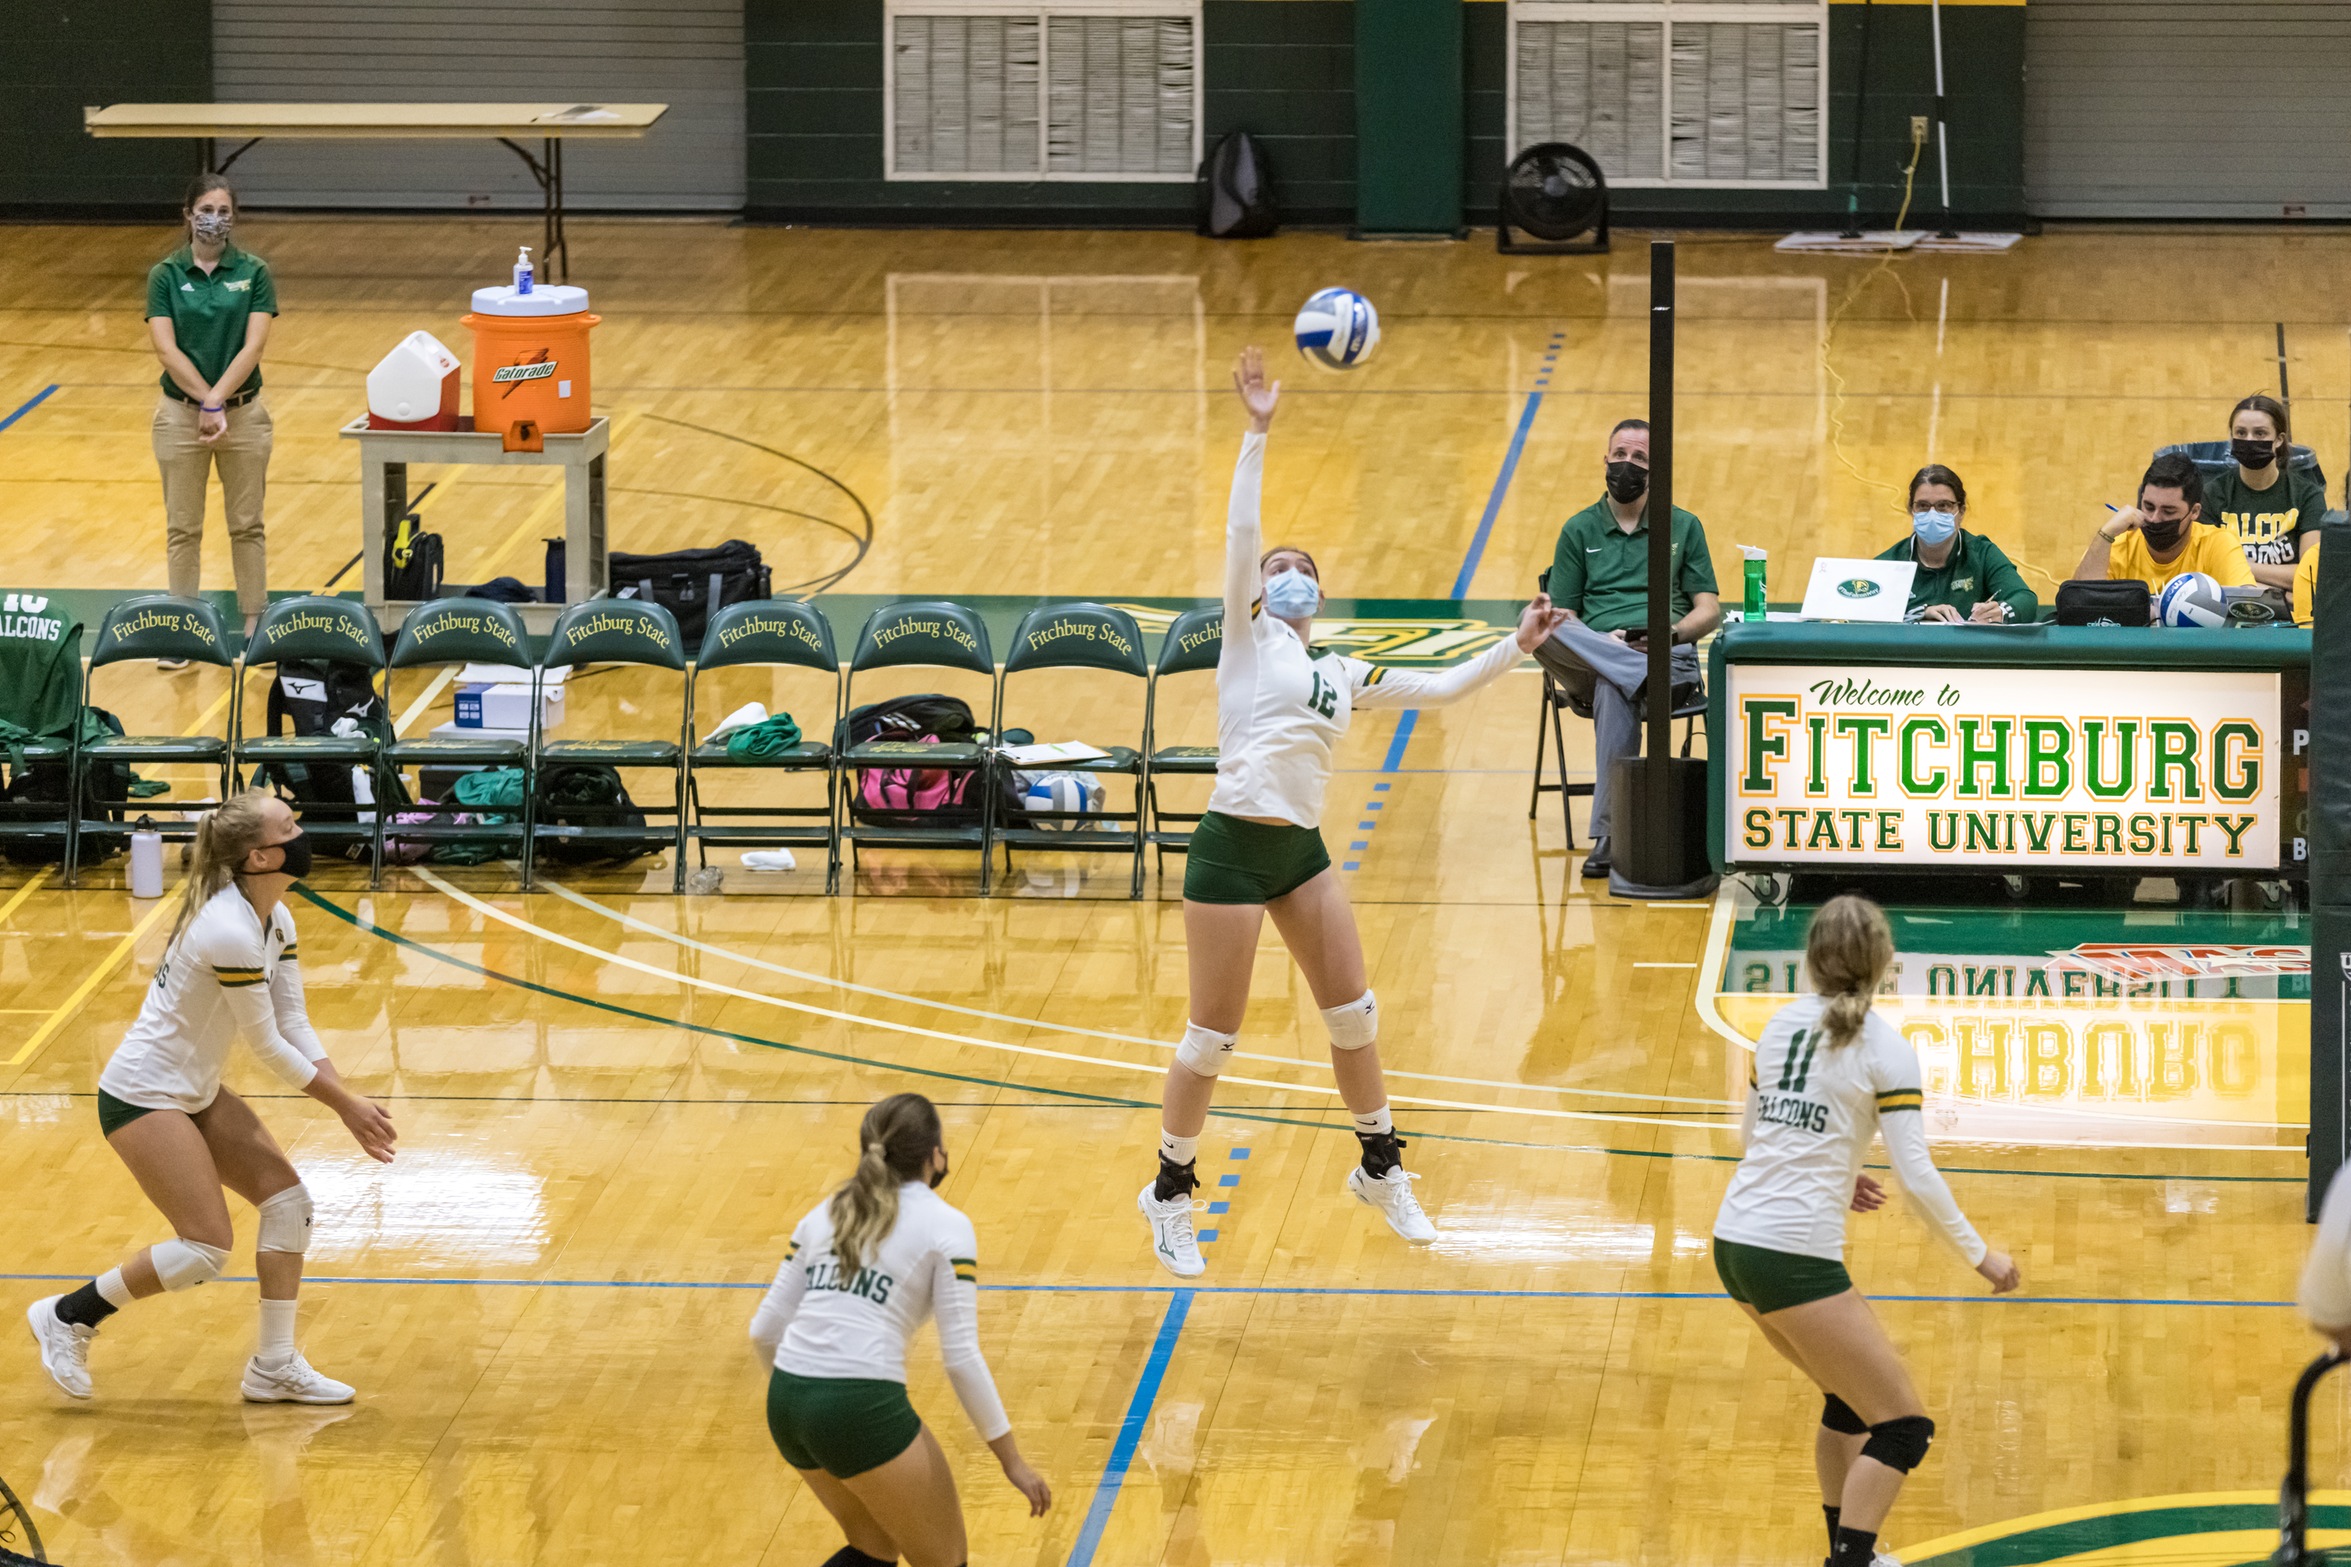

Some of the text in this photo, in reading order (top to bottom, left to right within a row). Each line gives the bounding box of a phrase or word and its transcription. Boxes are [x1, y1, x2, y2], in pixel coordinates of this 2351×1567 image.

[494, 362, 555, 381] Gatorade
[112, 610, 216, 646] Fitchburg State
[265, 611, 369, 647] Fitchburg State
[412, 612, 516, 648] Fitchburg State
[566, 613, 670, 649] Fitchburg State
[719, 616, 822, 652] Fitchburg State
[872, 617, 977, 652] Fitchburg State
[1027, 619, 1132, 656] Fitchburg State
[1179, 620, 1222, 654] Fitchb
[1307, 670, 1338, 720] 12
[1809, 677, 1961, 706] Welcome to
[1739, 694, 2264, 805] FITCHBURG
[1743, 807, 2258, 858] STATE UNIVERSITY
[1777, 1028, 1823, 1093] 11
